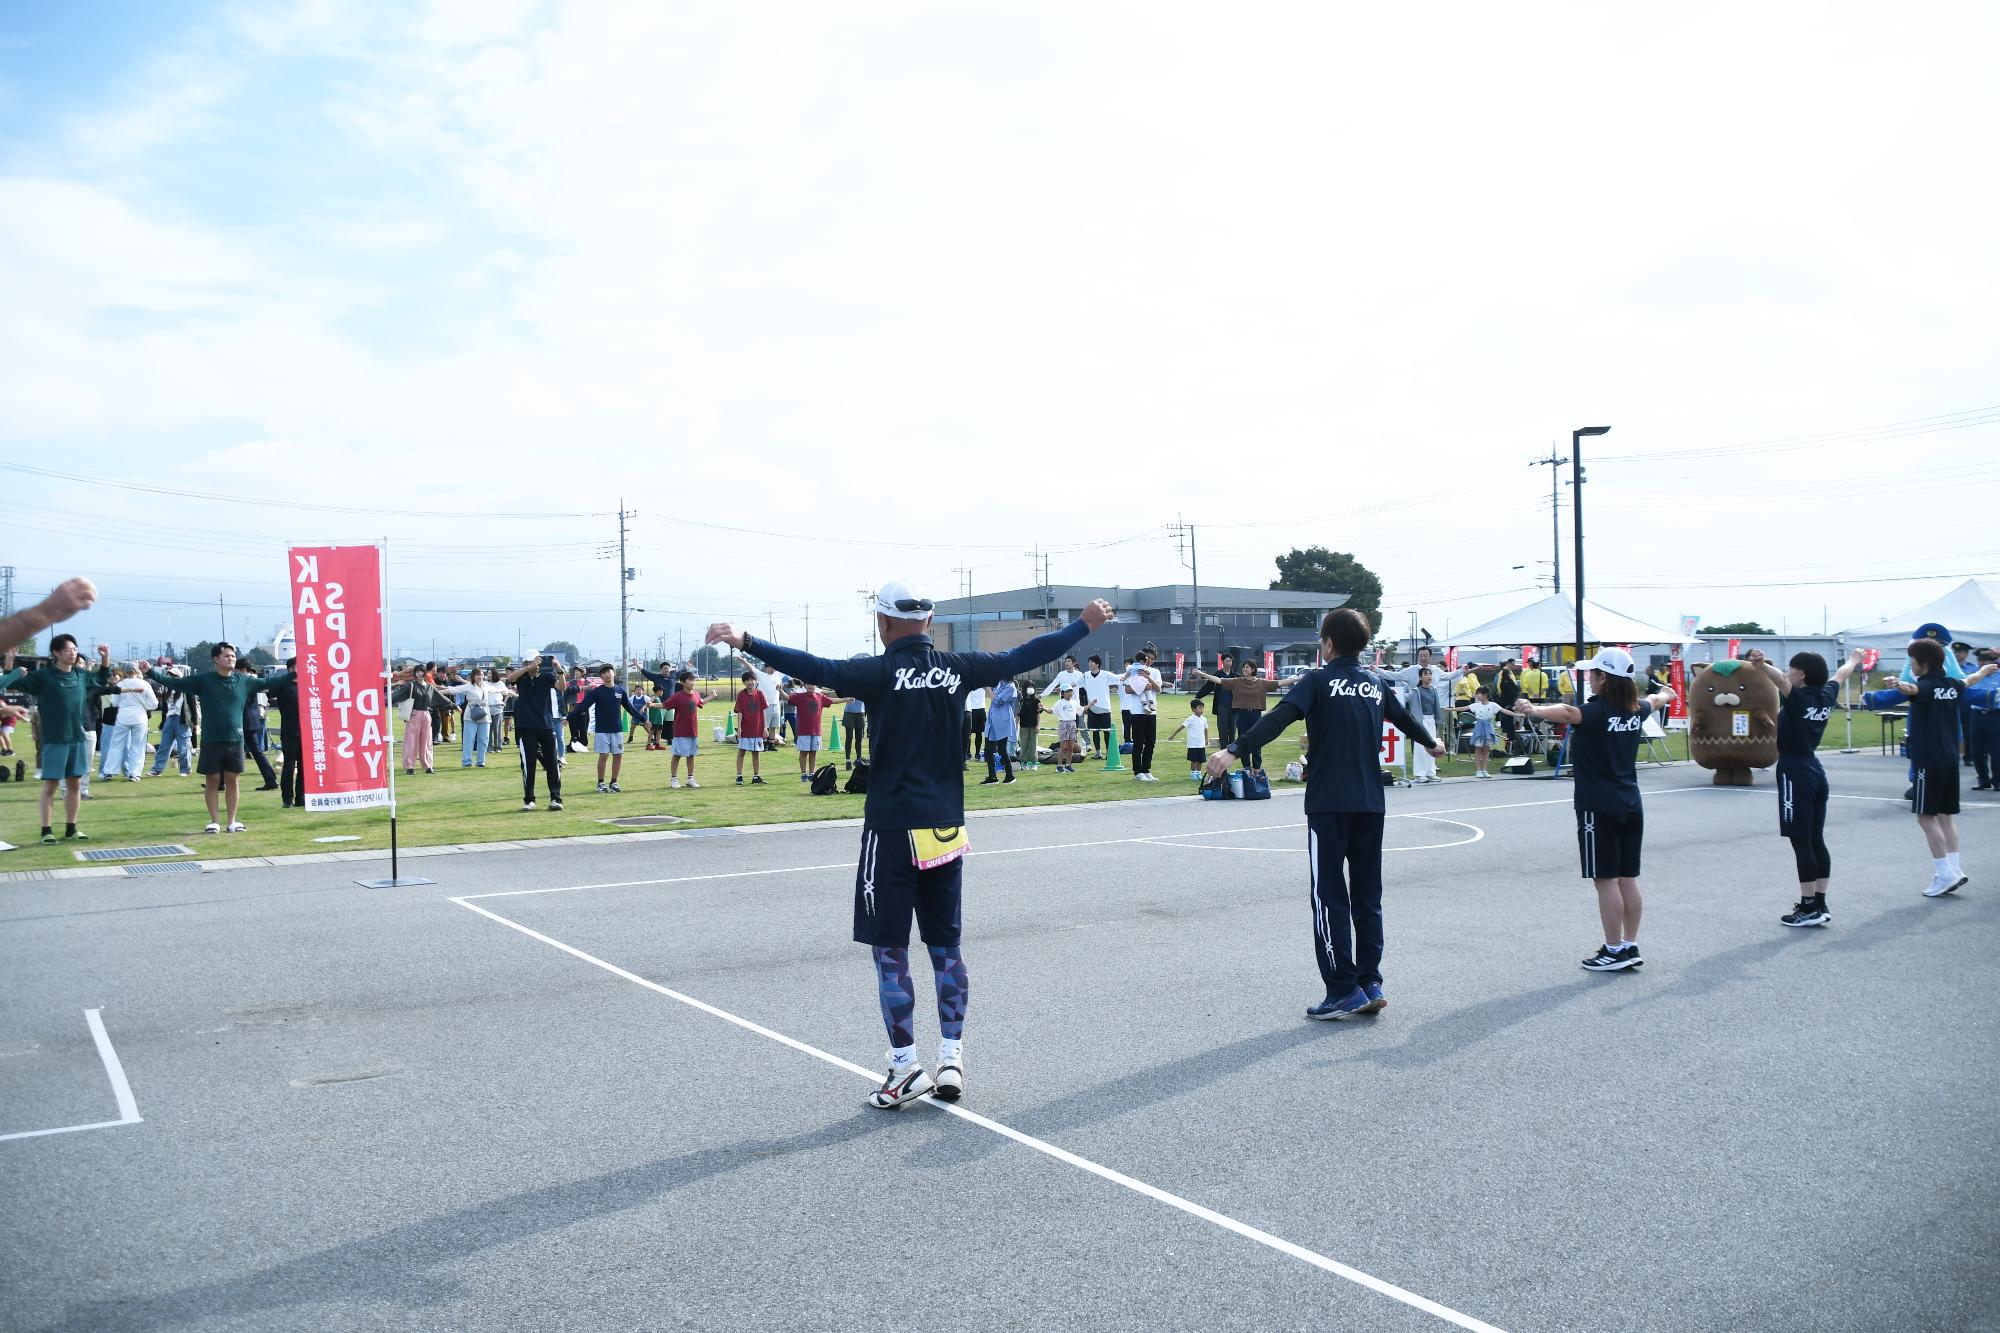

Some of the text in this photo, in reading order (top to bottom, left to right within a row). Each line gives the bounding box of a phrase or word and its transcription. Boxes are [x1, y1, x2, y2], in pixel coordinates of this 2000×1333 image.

[893, 667, 926, 691] Kai
[1328, 678, 1383, 706] Kai City
